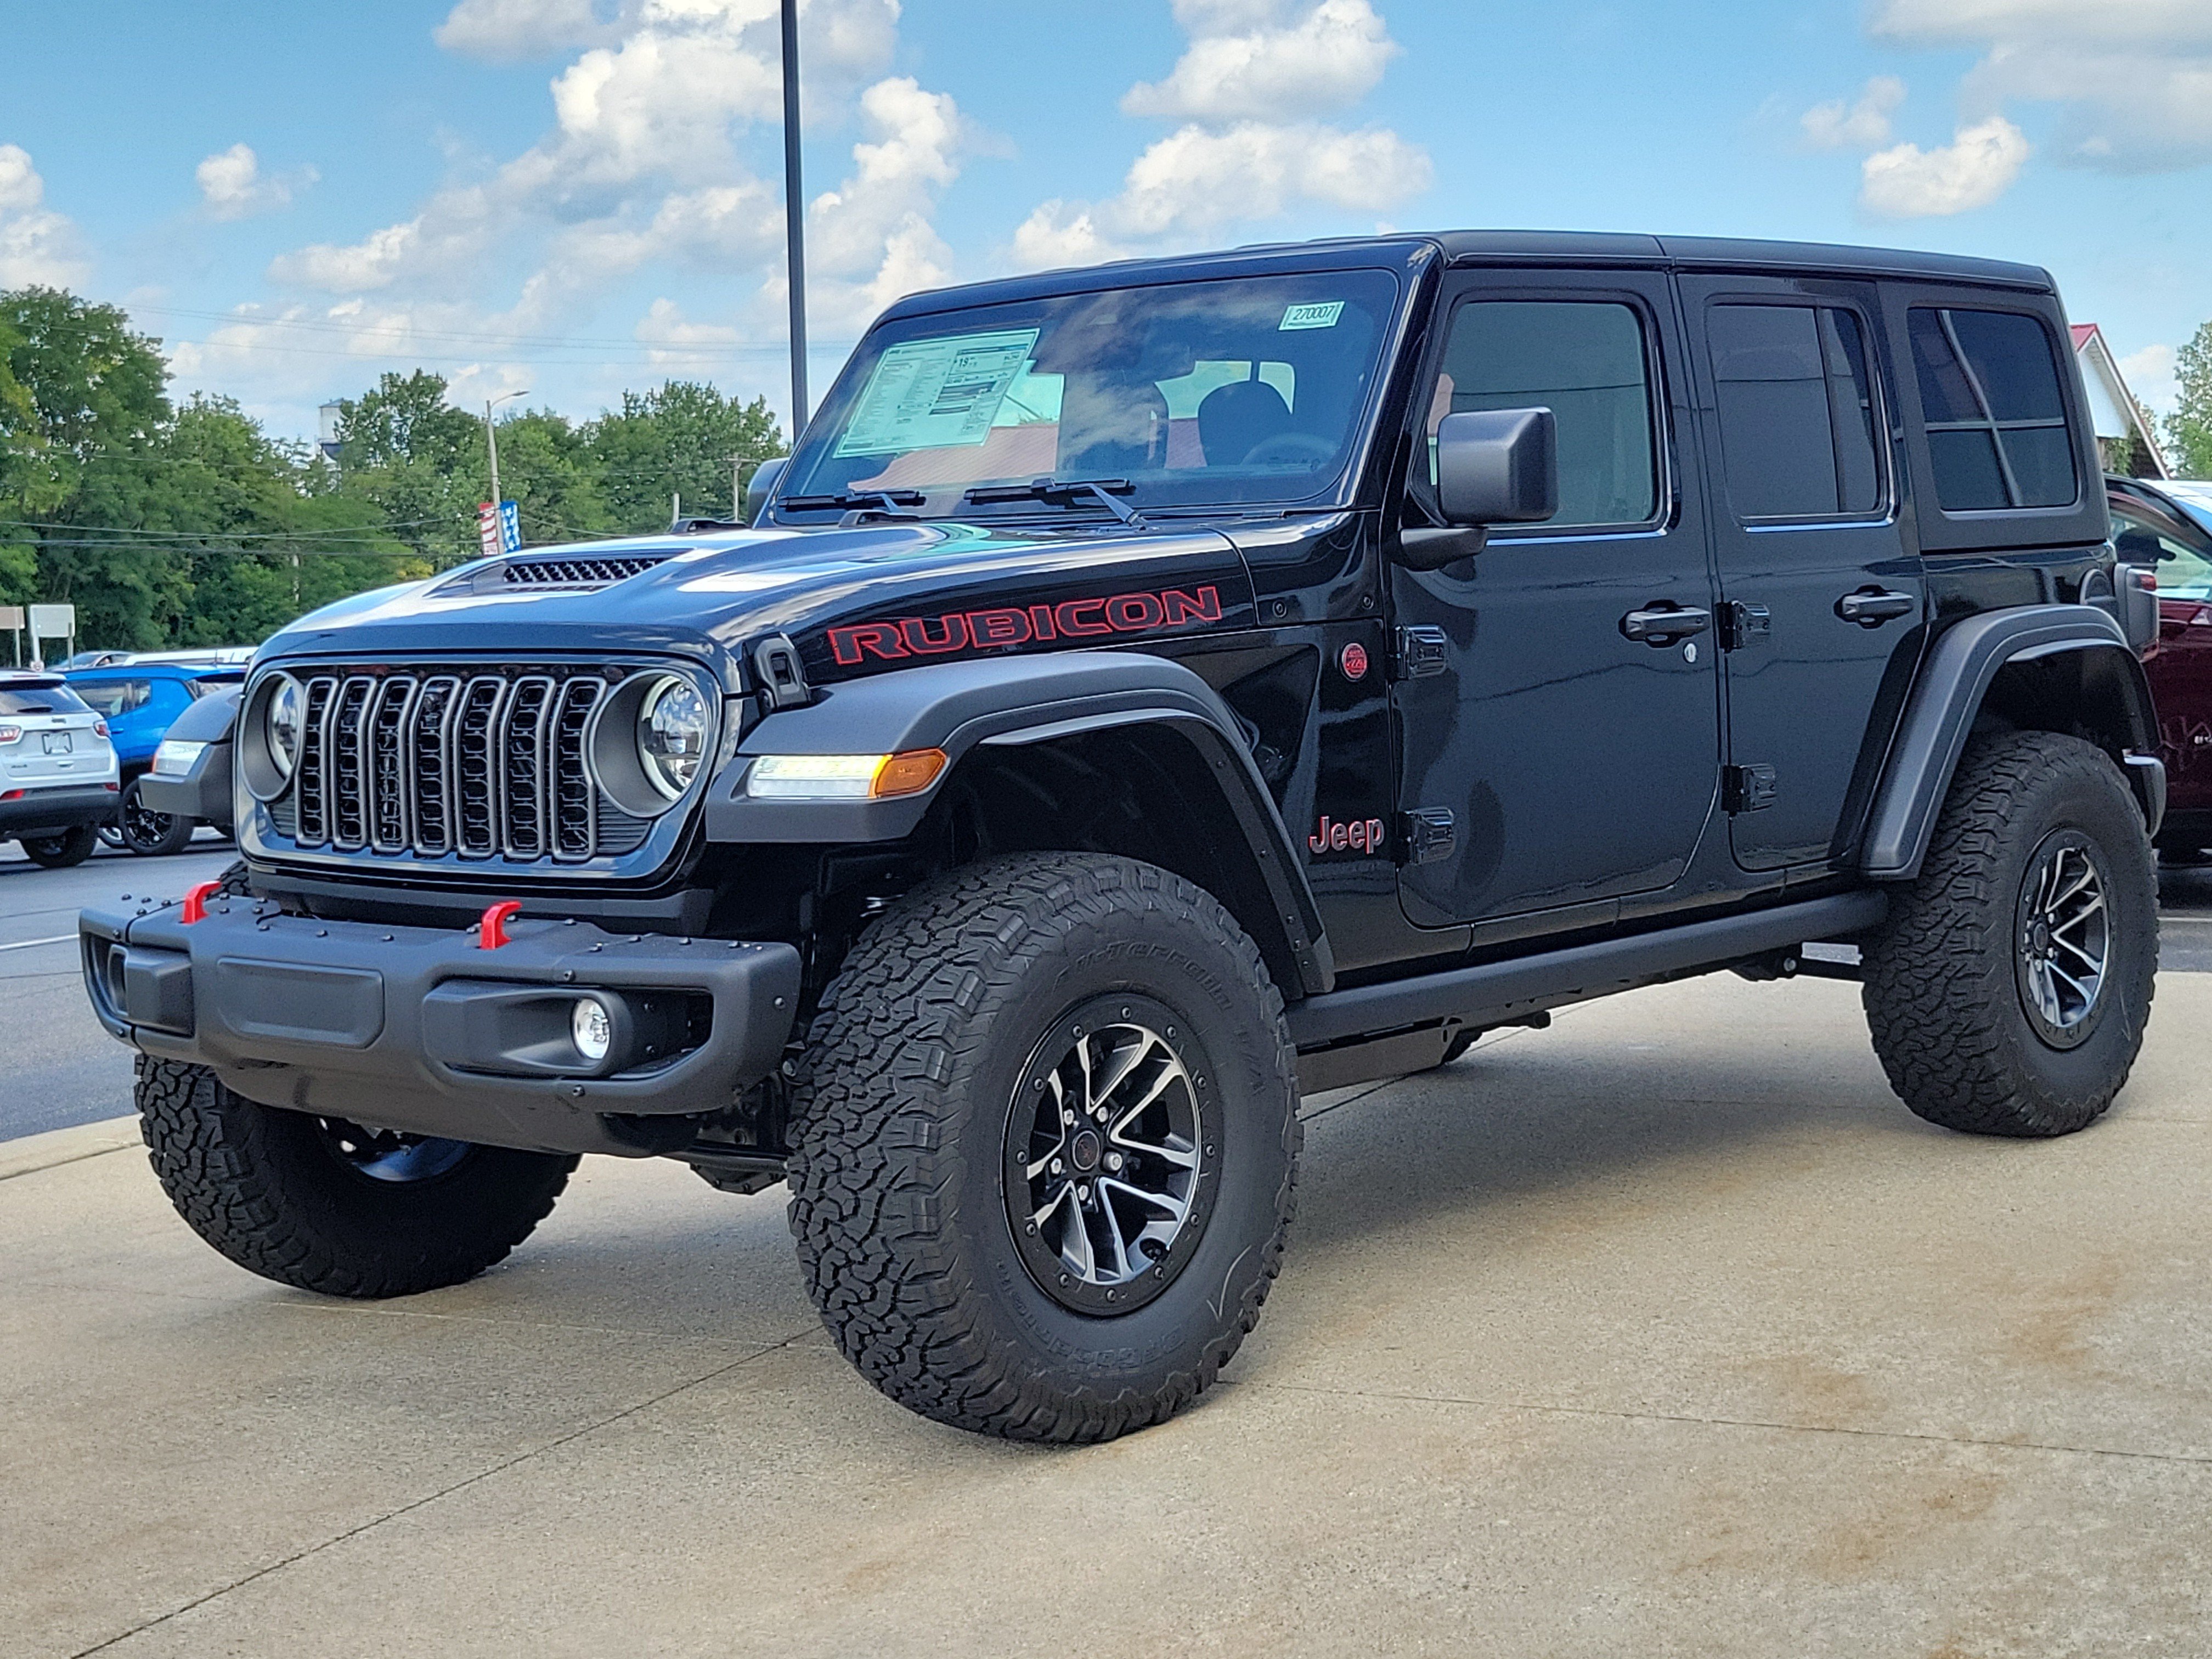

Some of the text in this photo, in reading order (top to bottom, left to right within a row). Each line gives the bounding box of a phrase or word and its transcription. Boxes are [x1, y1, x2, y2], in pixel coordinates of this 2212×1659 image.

[1293, 305, 1335, 320] 270007
[828, 585, 1222, 665] RUBICON
[1308, 816, 1385, 855] Jeep
